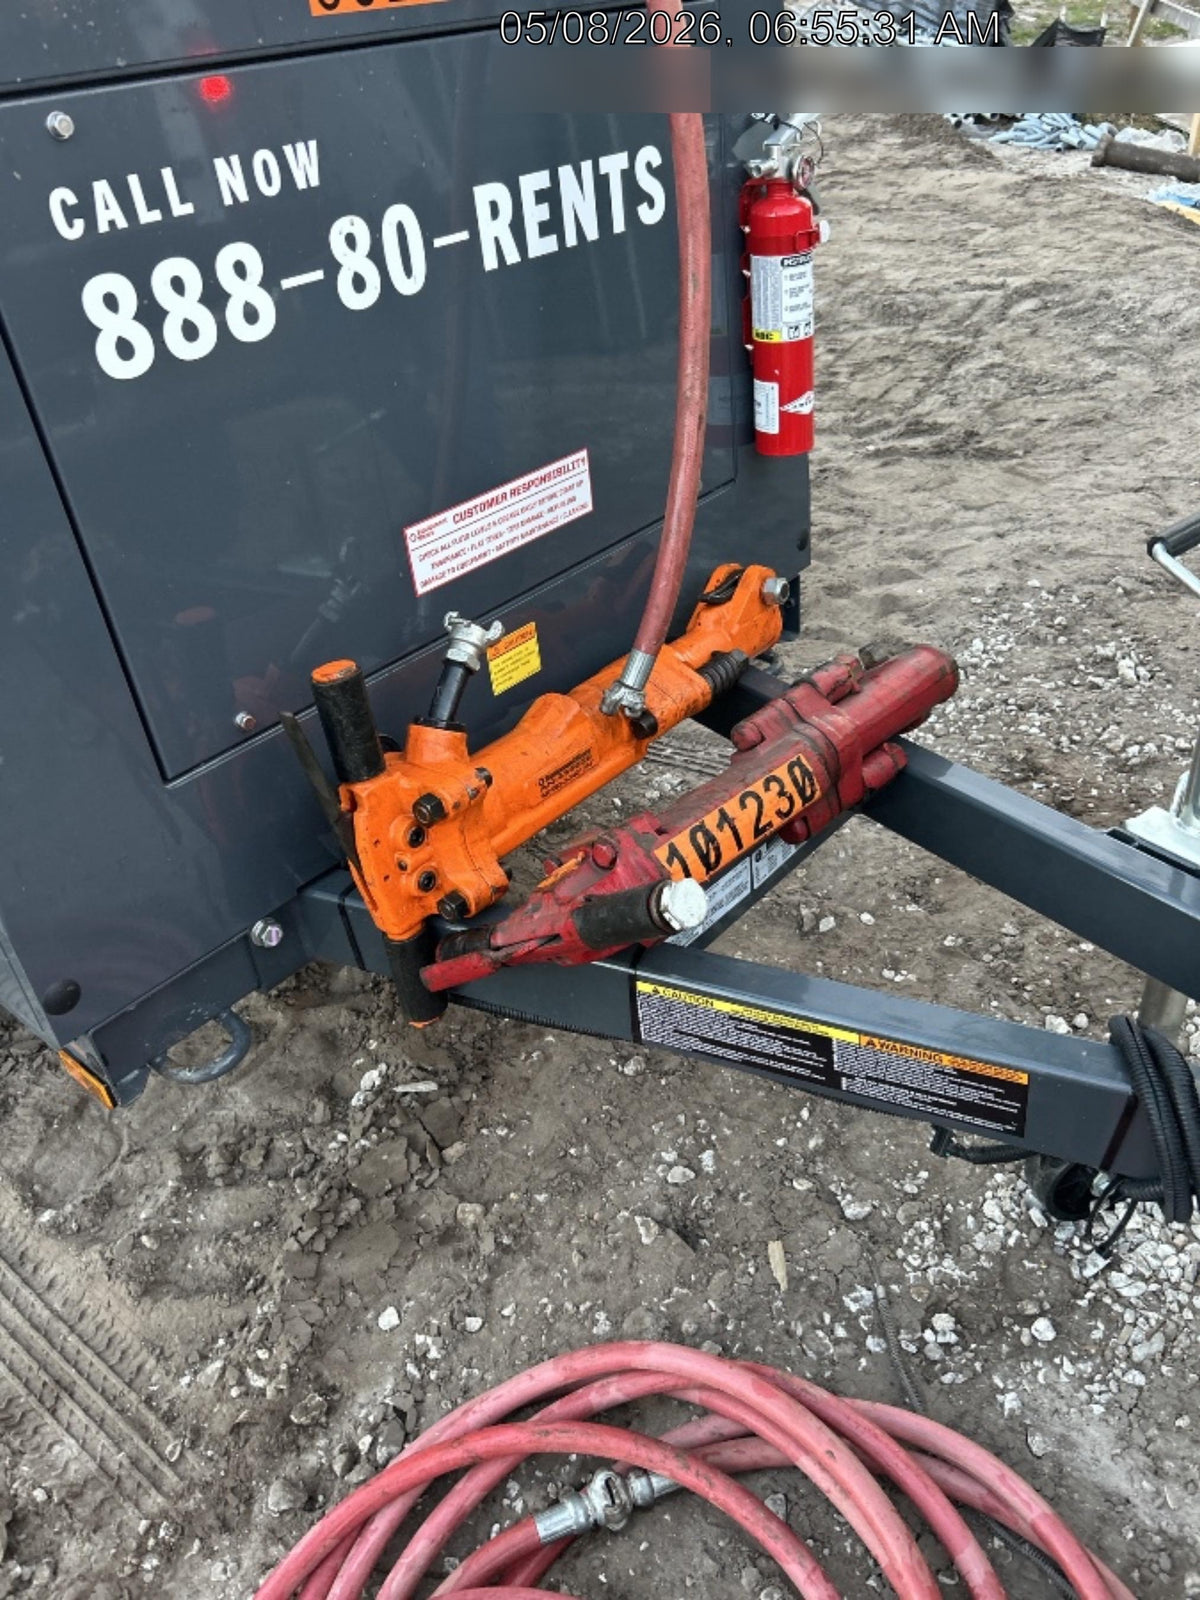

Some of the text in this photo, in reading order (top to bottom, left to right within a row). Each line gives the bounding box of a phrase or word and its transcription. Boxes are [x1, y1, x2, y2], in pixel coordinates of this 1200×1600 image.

[49, 139, 321, 241] CALL NOW
[80, 144, 667, 380] 888-80-RENTS
[452, 491, 507, 525] CUSTOMER
[509, 456, 586, 500] RESPONSIBILITY
[665, 755, 817, 879] 101230
[662, 989, 714, 1008] CAUTION
[879, 1041, 943, 1063] WARNING
